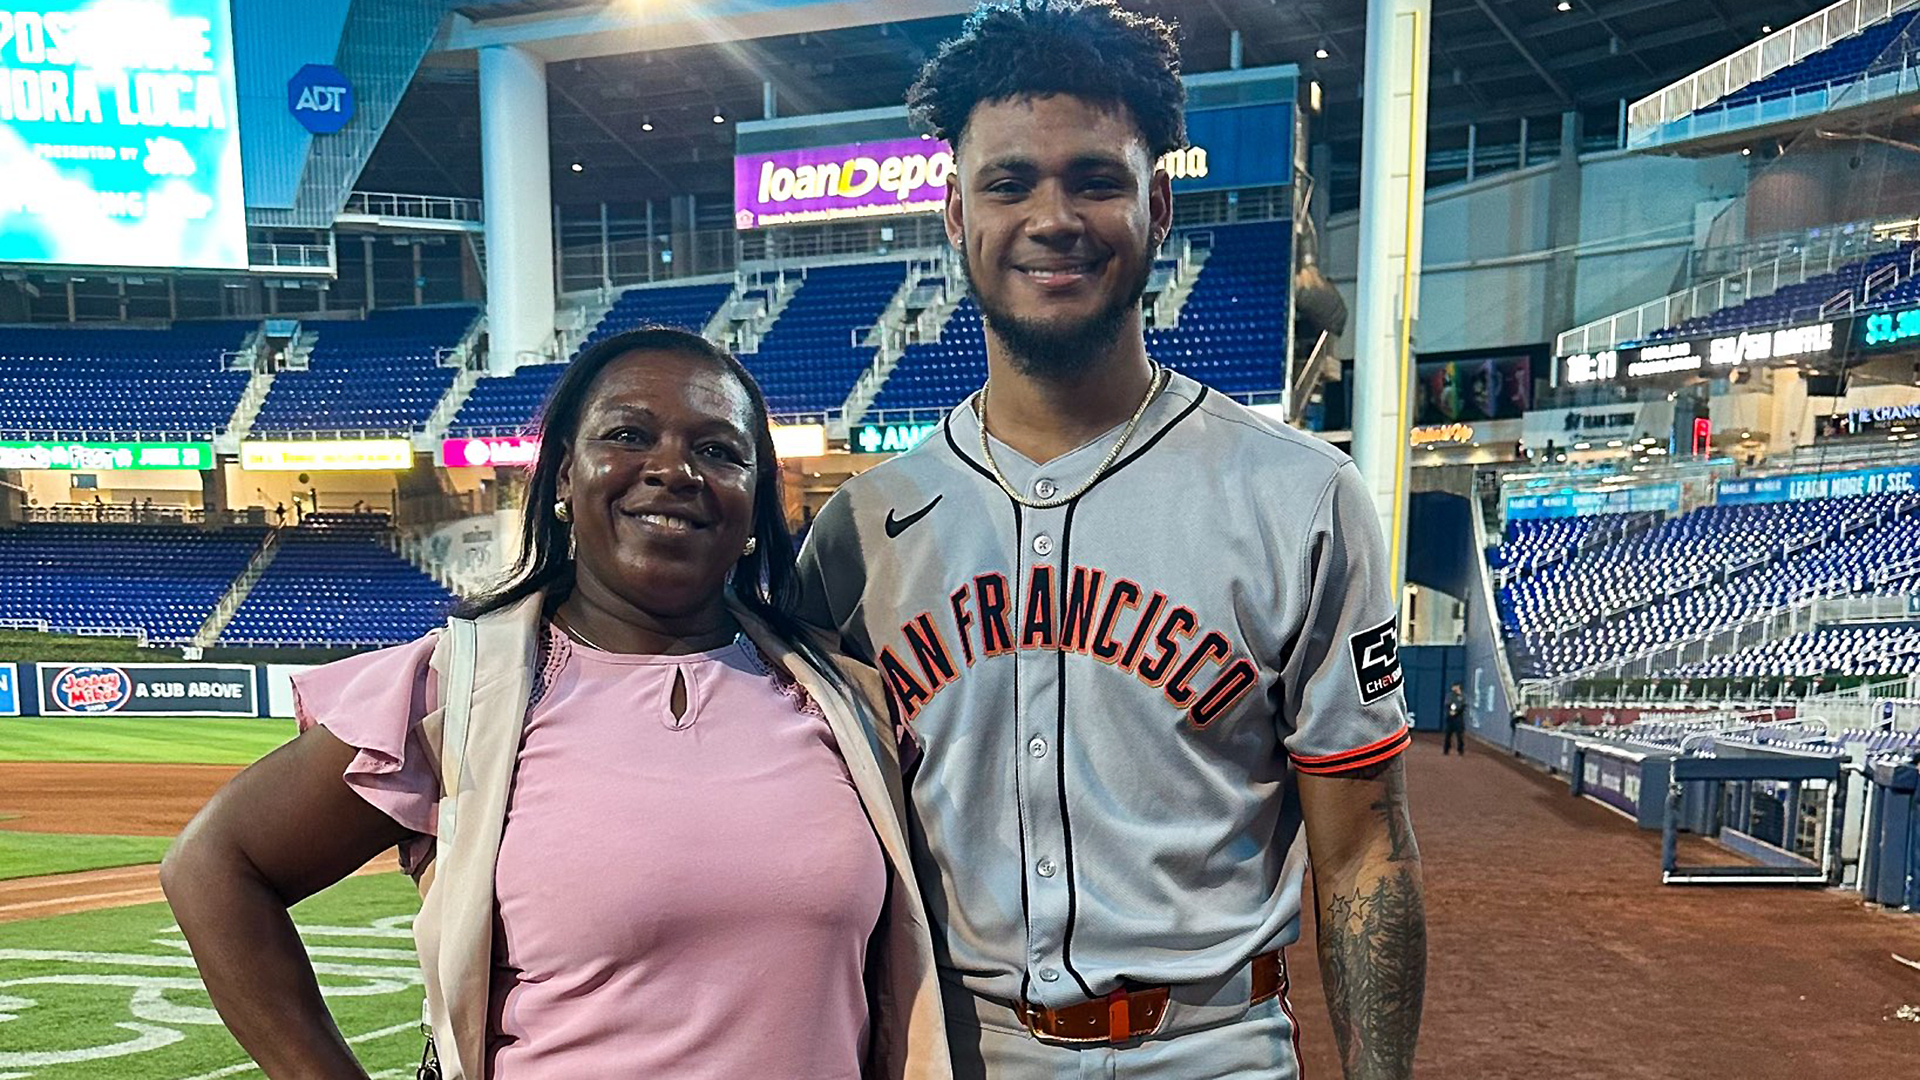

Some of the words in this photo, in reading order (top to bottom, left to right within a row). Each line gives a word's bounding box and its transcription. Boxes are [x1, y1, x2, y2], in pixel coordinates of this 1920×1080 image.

[115, 73, 225, 129] LOCA
[295, 87, 346, 112] ADT
[758, 152, 957, 203] loanDepo
[1867, 474, 1884, 493] AT
[877, 612, 960, 721] AN
[950, 564, 1259, 729] FRANCISCO
[62, 673, 121, 692] Jersey
[135, 685, 149, 698] A
[152, 684, 185, 698] SUB
[188, 683, 243, 698] ABOVE
